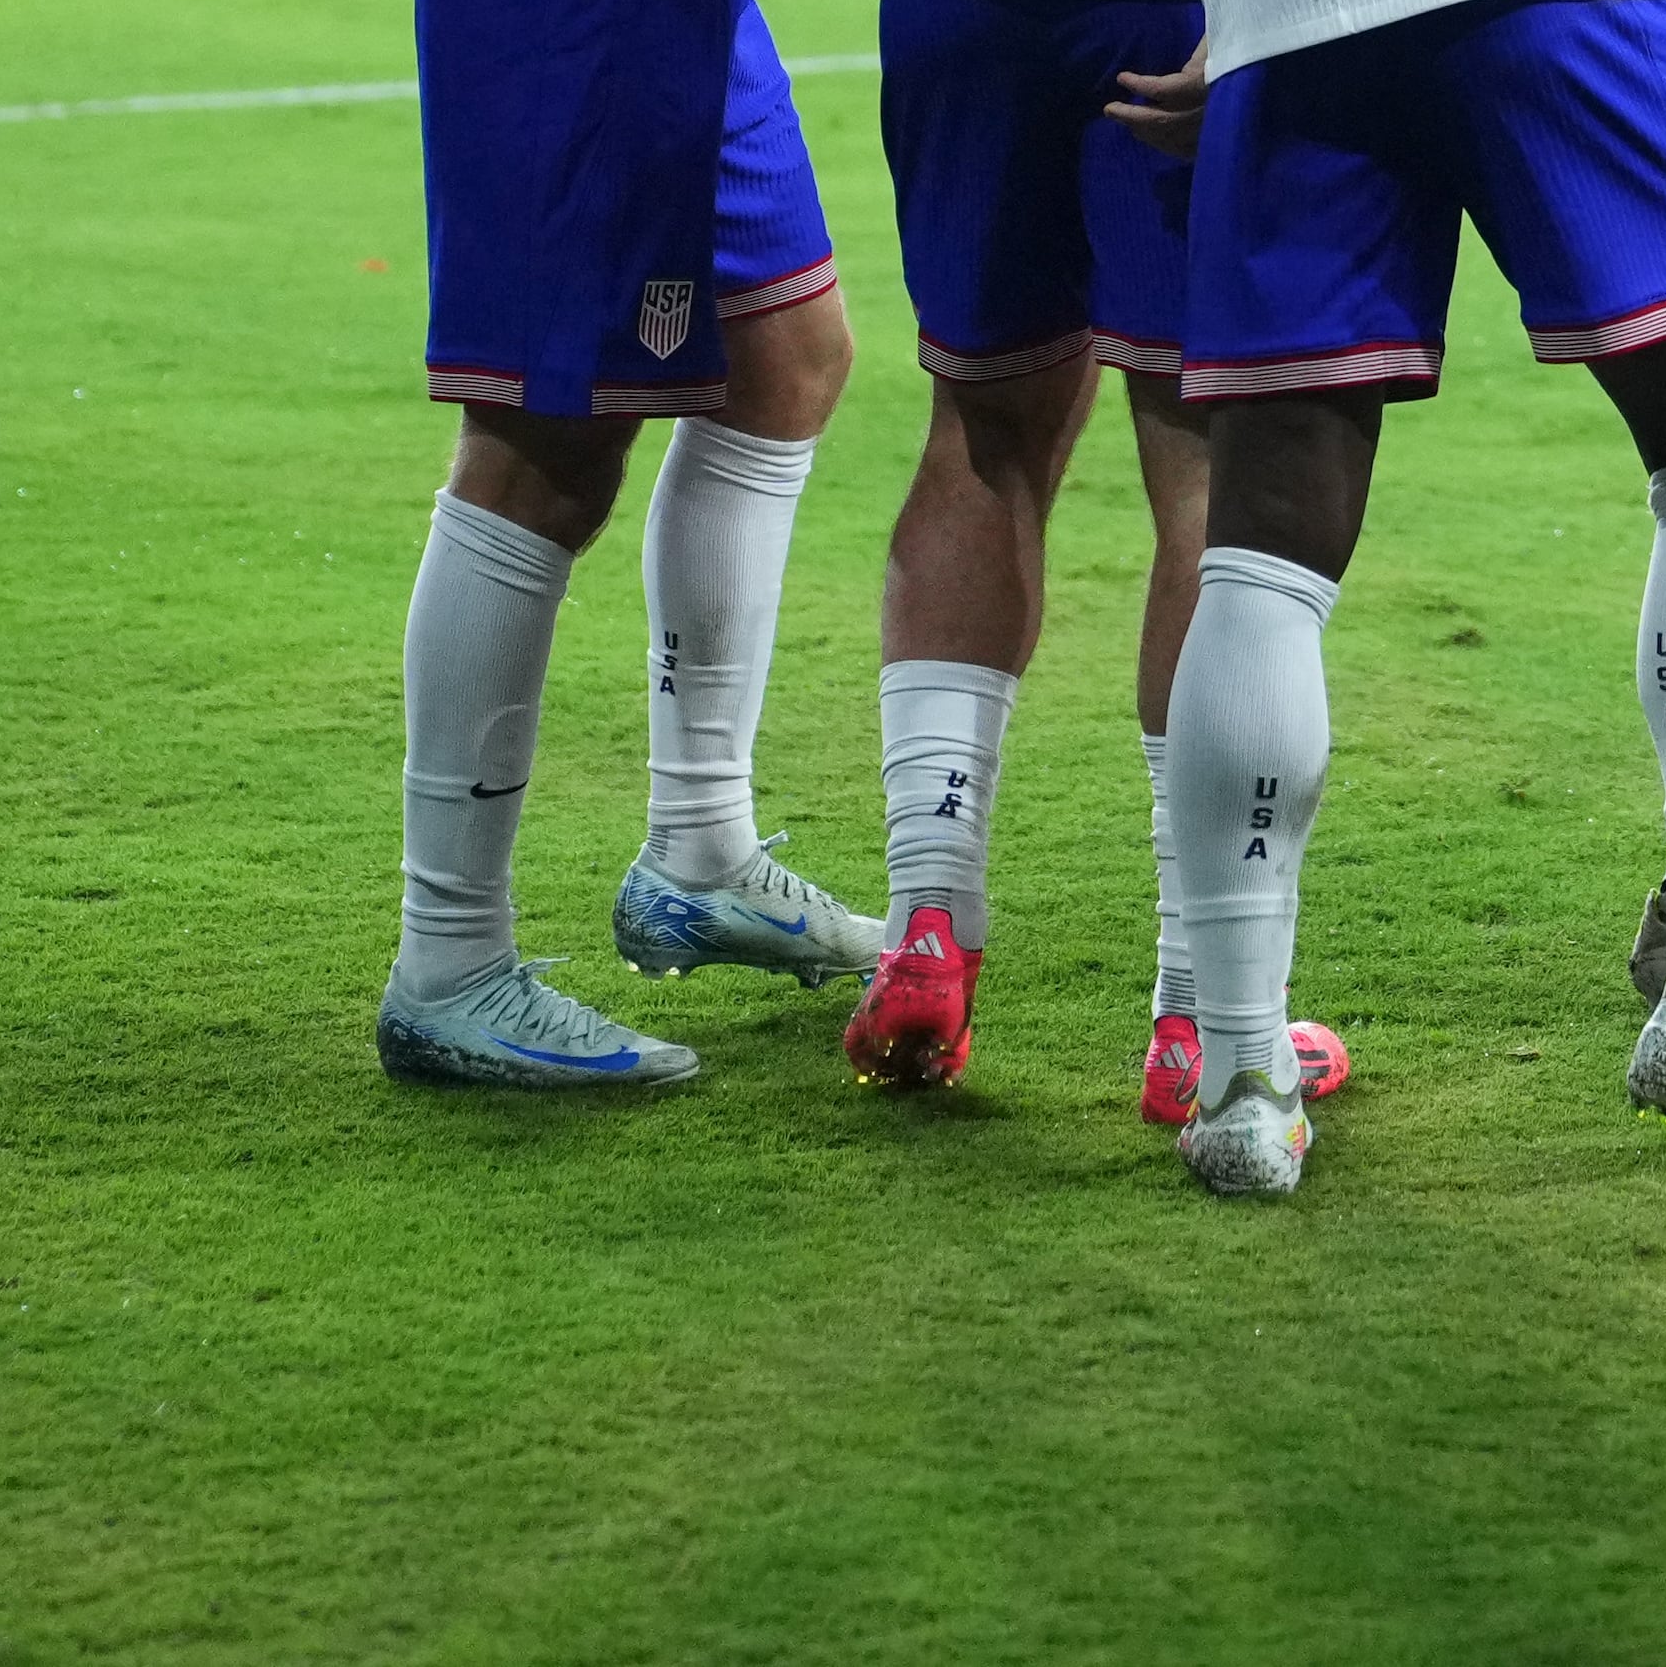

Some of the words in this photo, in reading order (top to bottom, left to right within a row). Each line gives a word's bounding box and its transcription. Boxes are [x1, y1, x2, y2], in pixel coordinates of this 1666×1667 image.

[645, 283, 691, 314] USA
[660, 631, 678, 696] USA
[1244, 777, 1278, 860] USA
